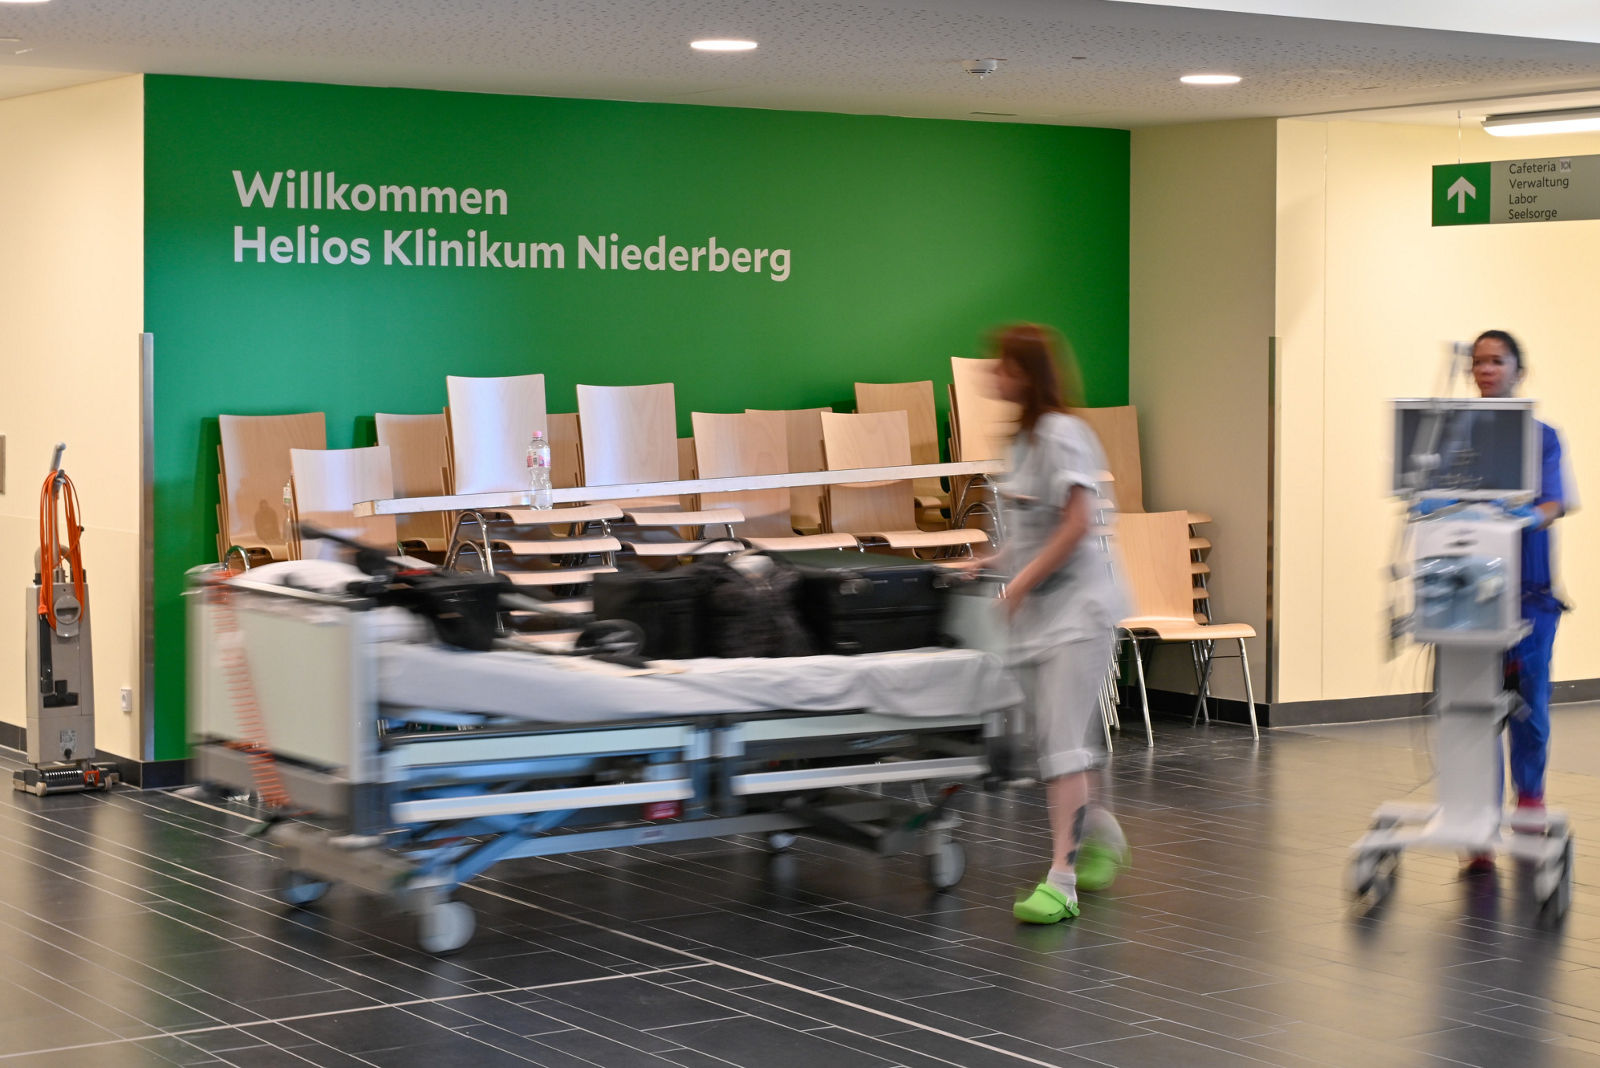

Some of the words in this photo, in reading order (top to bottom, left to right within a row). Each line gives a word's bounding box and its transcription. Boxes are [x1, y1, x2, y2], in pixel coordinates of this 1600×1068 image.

[1508, 161, 1557, 175] Cafeteria
[1509, 176, 1570, 190] Verwaltung
[231, 168, 508, 216] Willkommen
[1508, 193, 1538, 205] Labor
[1508, 207, 1558, 221] Seelsorge
[233, 224, 371, 266] Helios
[383, 227, 566, 269] Klinikum
[577, 232, 792, 283] Niederberg
